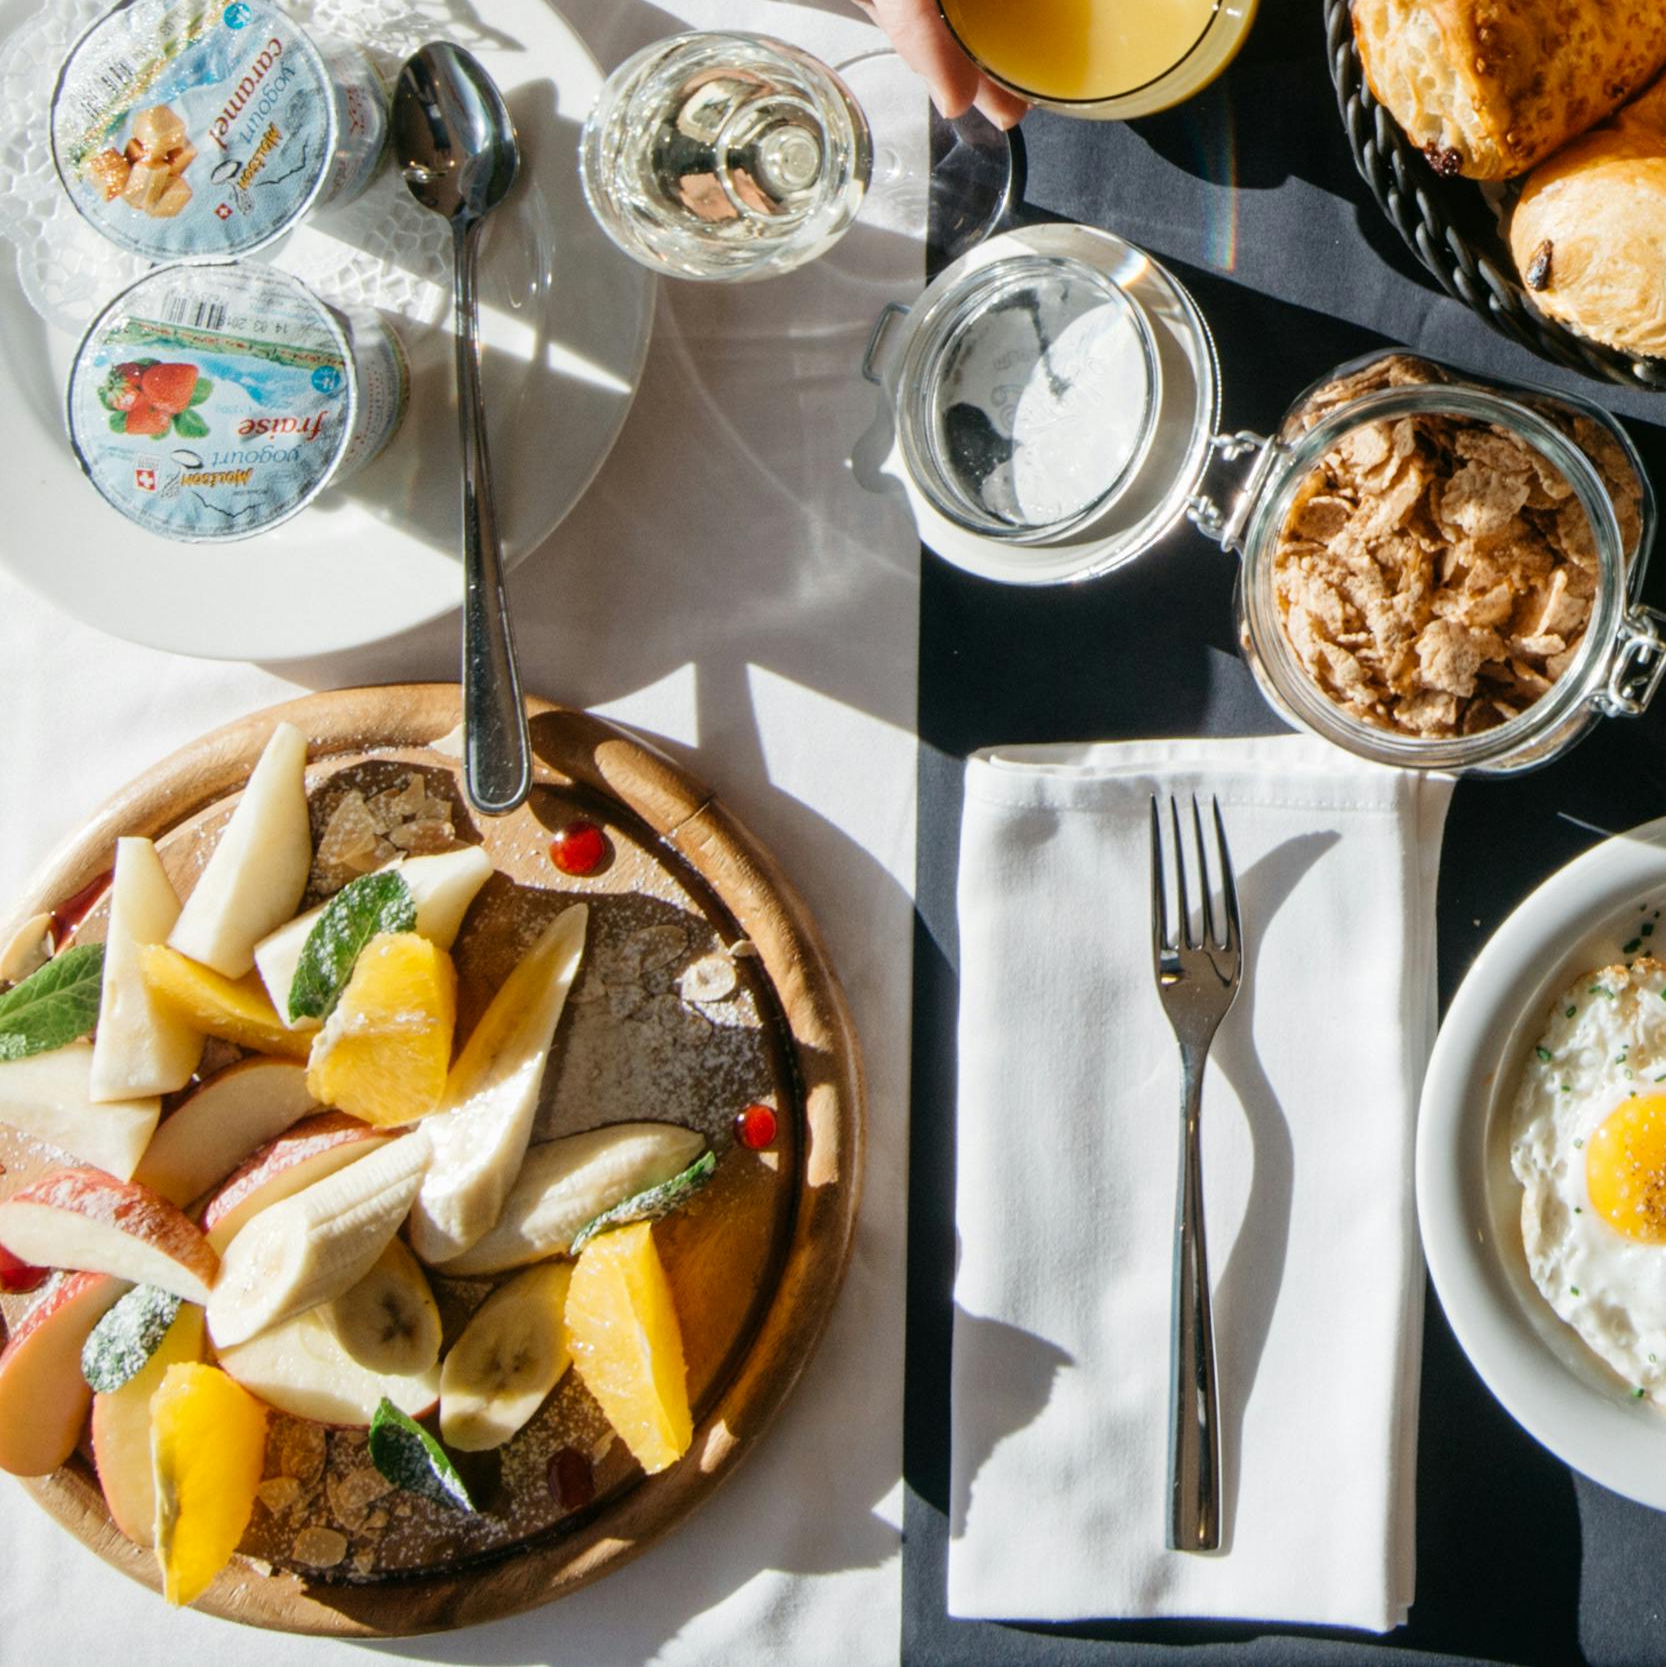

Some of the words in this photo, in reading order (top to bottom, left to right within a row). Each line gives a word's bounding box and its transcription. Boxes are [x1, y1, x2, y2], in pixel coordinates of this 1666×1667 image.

[208, 37, 283, 150] caramel
[238, 62, 297, 144] yogourt
[238, 411, 329, 441] fraise
[210, 444, 301, 466] yogourt
